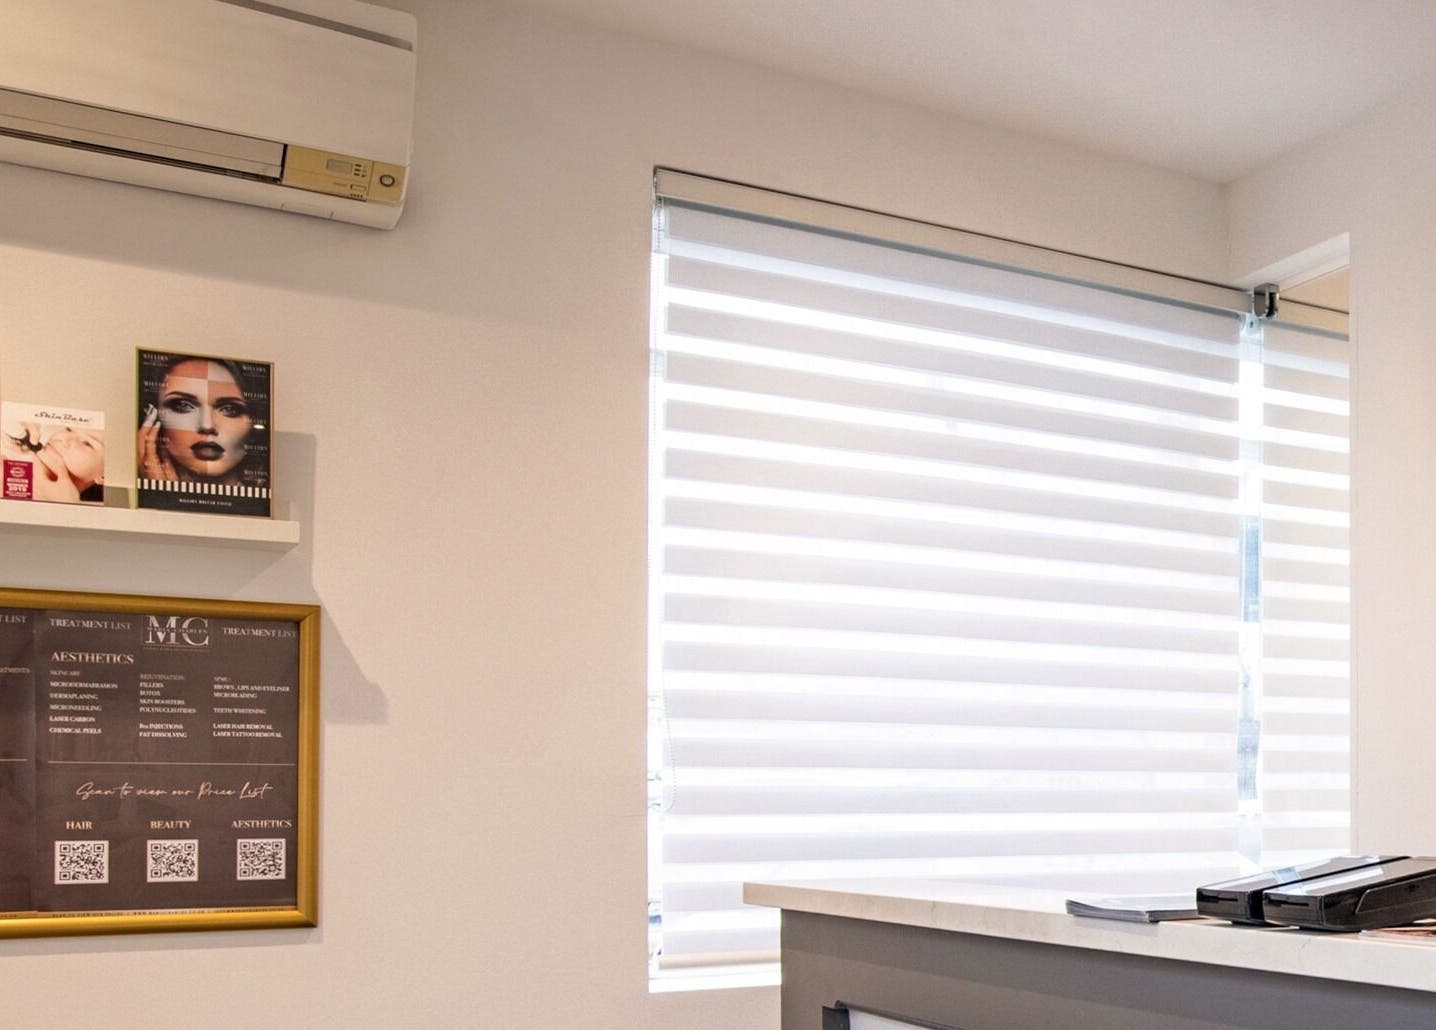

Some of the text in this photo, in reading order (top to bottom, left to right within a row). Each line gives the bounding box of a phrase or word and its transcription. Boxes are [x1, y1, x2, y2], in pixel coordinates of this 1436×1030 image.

[50, 618, 131, 630] TREATMENT LIST
[144, 616, 209, 646] MC
[222, 627, 276, 637] TREATMENT
[51, 652, 134, 664] AESTHETICS
[76, 782, 273, 800] Scan to view our Price List
[66, 821, 93, 830] HAIR
[151, 820, 192, 830] BEAUTY
[232, 819, 293, 829] AESTHETICS
